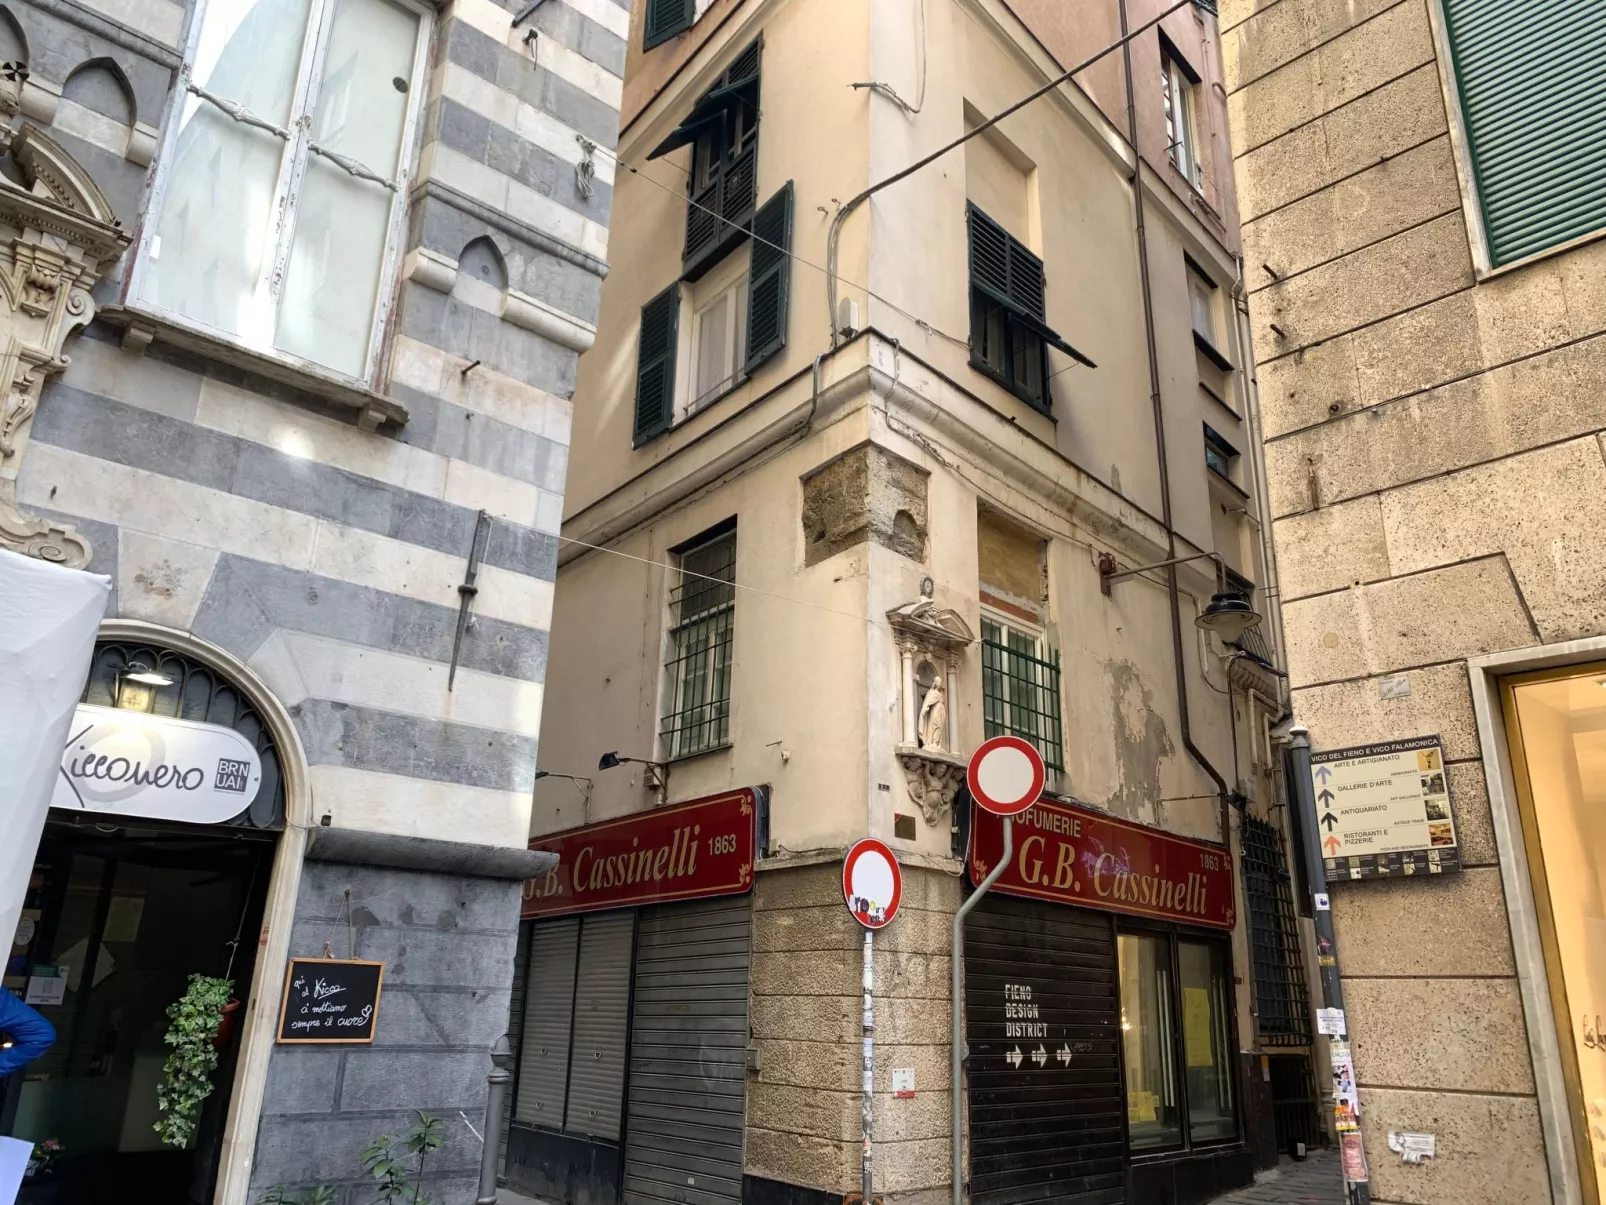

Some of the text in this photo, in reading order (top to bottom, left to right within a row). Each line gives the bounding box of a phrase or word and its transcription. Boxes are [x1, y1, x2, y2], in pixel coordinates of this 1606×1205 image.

[1311, 754, 1328, 763] VICO
[1329, 752, 1343, 760] DEL
[1344, 748, 1365, 758] FIENO
[1372, 745, 1390, 755] VICO
[1391, 738, 1439, 751] FALAMONICA
[218, 760, 249, 777] BRN
[1334, 760, 1351, 768] ARTE
[1357, 754, 1400, 765] ARTIGIANATO
[216, 774, 241, 789] UAI
[1337, 780, 1393, 792] GALLERIE D'ARTE
[1340, 805, 1387, 815] ANTIQUARIATO
[1344, 830, 1383, 839] RISTORANTI
[1344, 837, 1374, 845] PIZZERIE
[573, 825, 700, 892] Cassinelli
[708, 833, 736, 855] 1863
[1199, 853, 1219, 872] 1863
[1019, 835, 1207, 915] G.B. Cassinelli
[1005, 984, 1032, 1000] FIENO
[1005, 1002, 1039, 1019] DESIGN
[1005, 1022, 1048, 1038] DISTRICT
